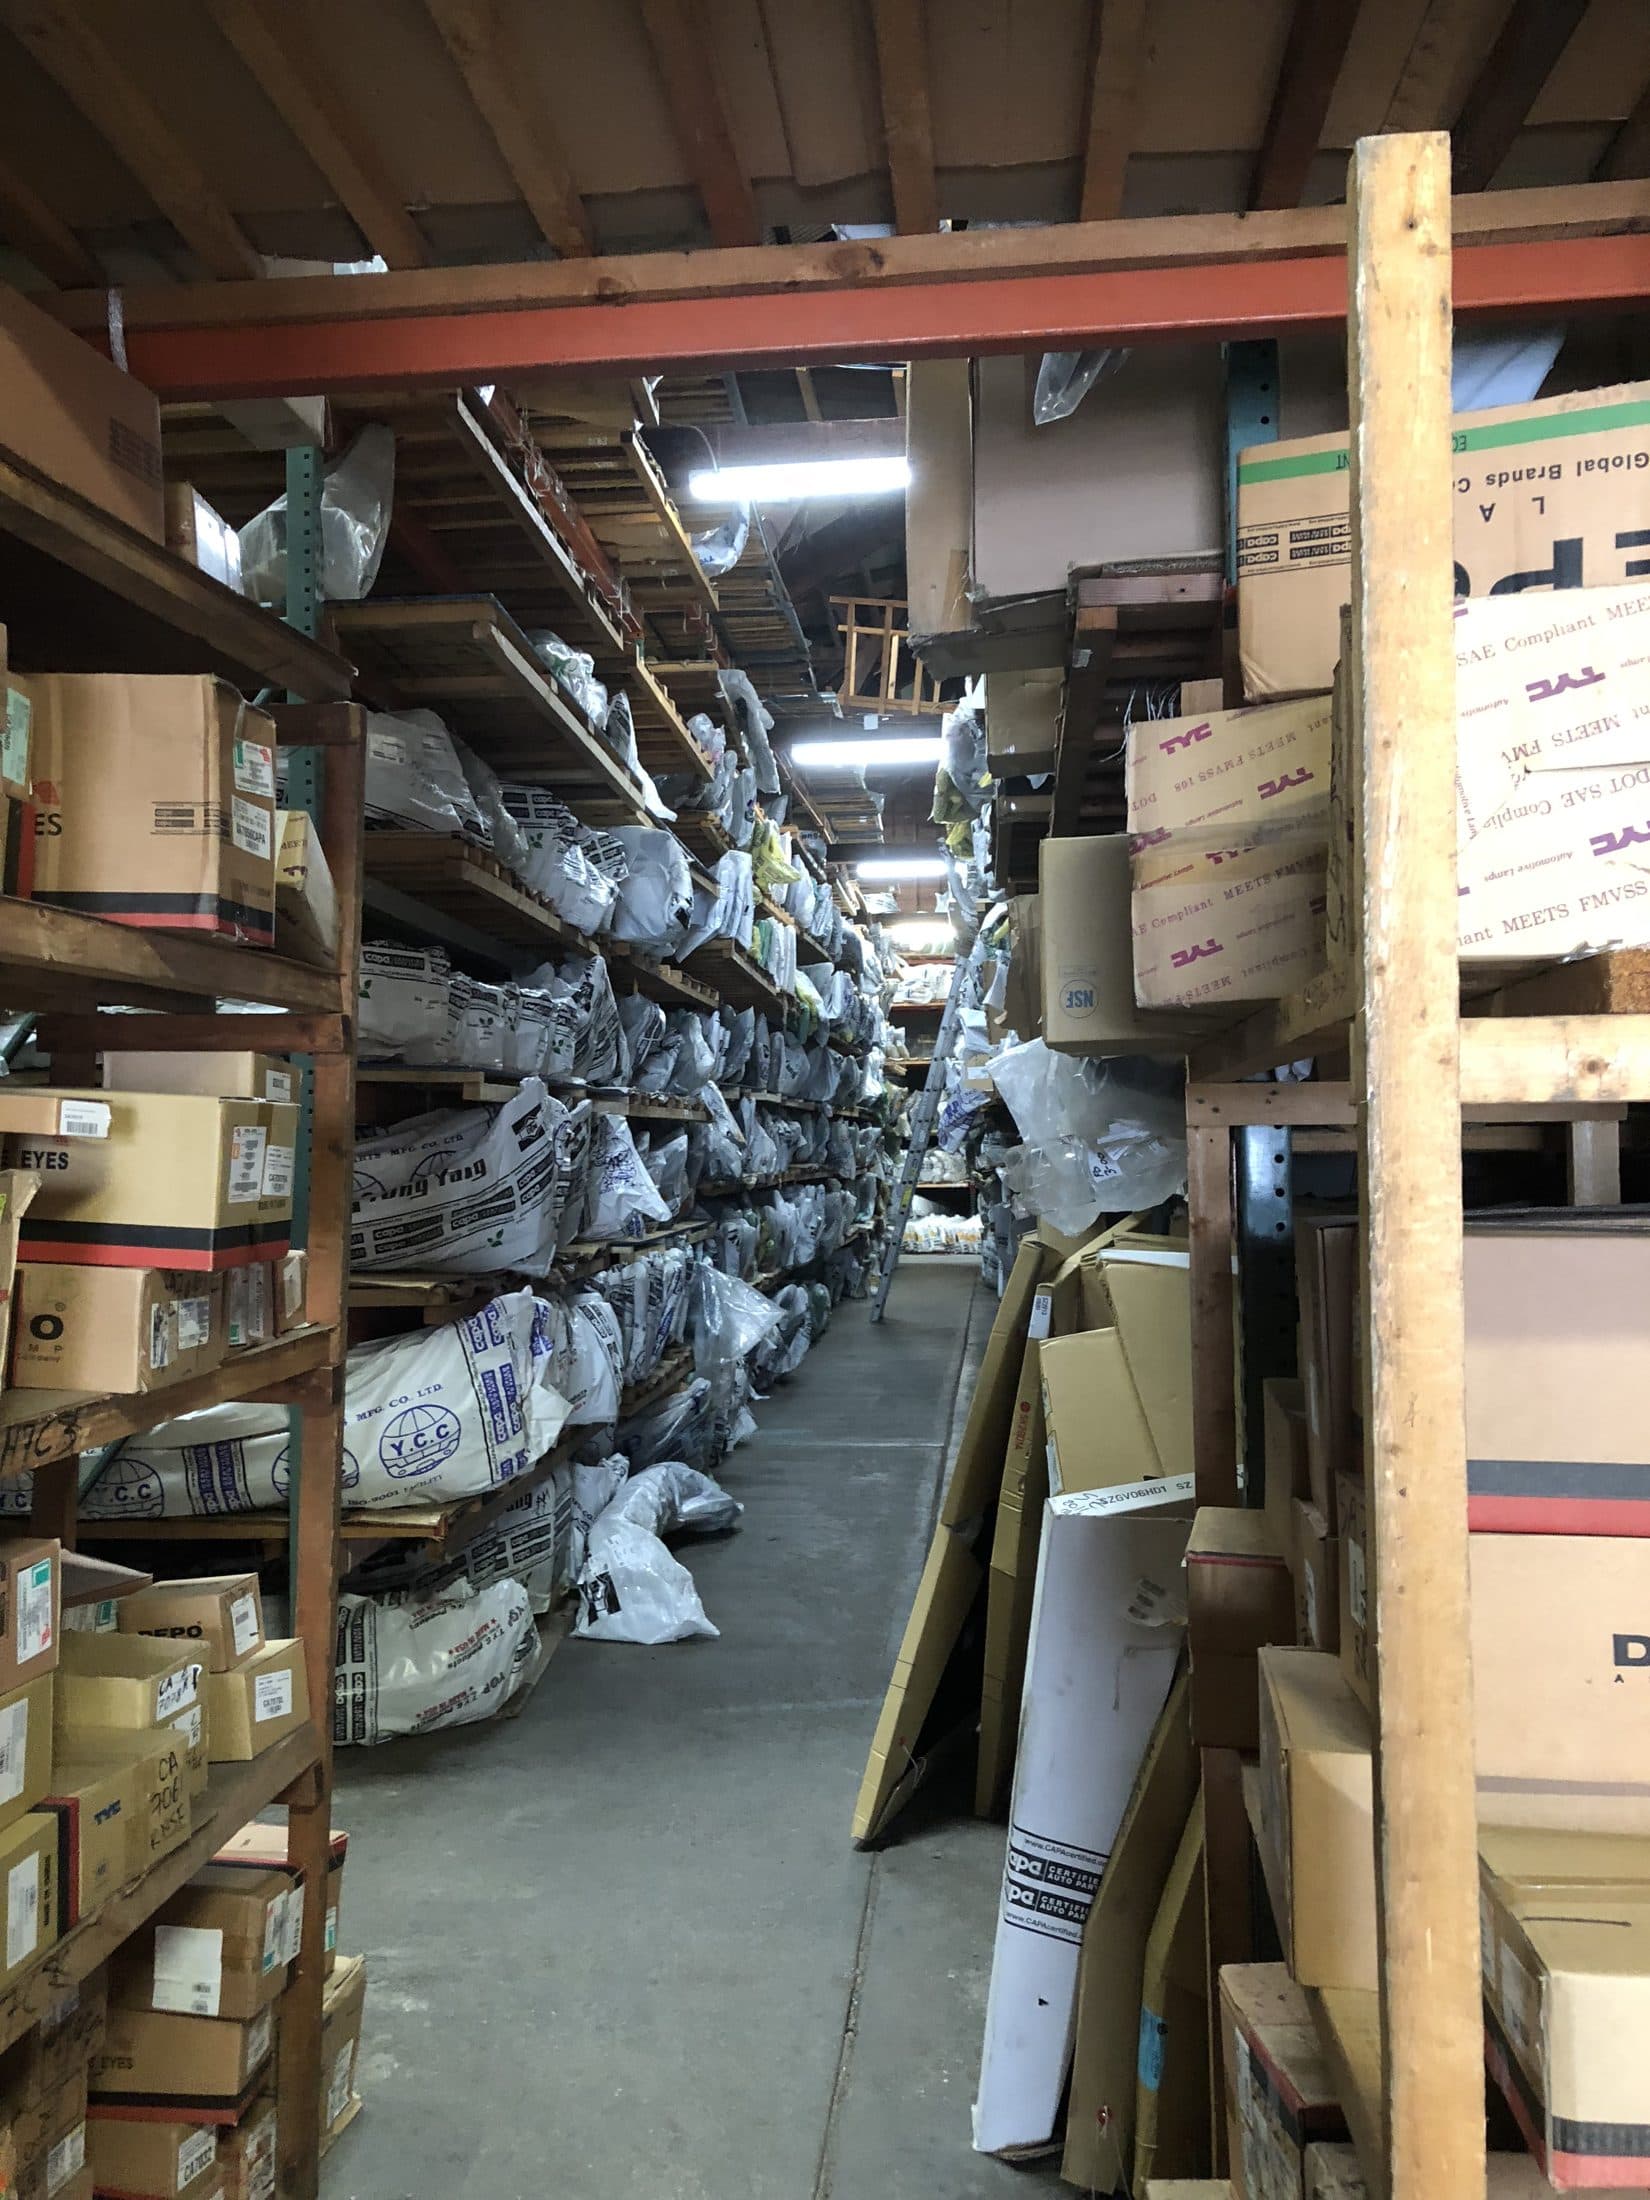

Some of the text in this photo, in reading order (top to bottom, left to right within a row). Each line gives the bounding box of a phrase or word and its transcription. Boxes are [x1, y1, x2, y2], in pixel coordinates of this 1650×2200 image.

[1453, 452, 1650, 493] Global Brands C
[1503, 615, 1596, 652] Compliant
[1525, 665, 1607, 703] TYC
[1158, 722, 1213, 755] TYC
[1551, 714, 1621, 747] MEETS
[1257, 766, 1315, 801] TYC
[1560, 783, 1603, 808] SAE
[1502, 903, 1571, 935] MEETS
[1578, 880, 1649, 913] FMVSS
[1170, 938, 1225, 969] TYC
[21, 1150, 69, 1170] EYES
[356, 1403, 384, 1422] MFG.
[1047, 1873, 1073, 1885] AUTO
[1048, 1865, 1099, 1885] CERTIFIE
[1039, 1903, 1065, 1915] AUTO
